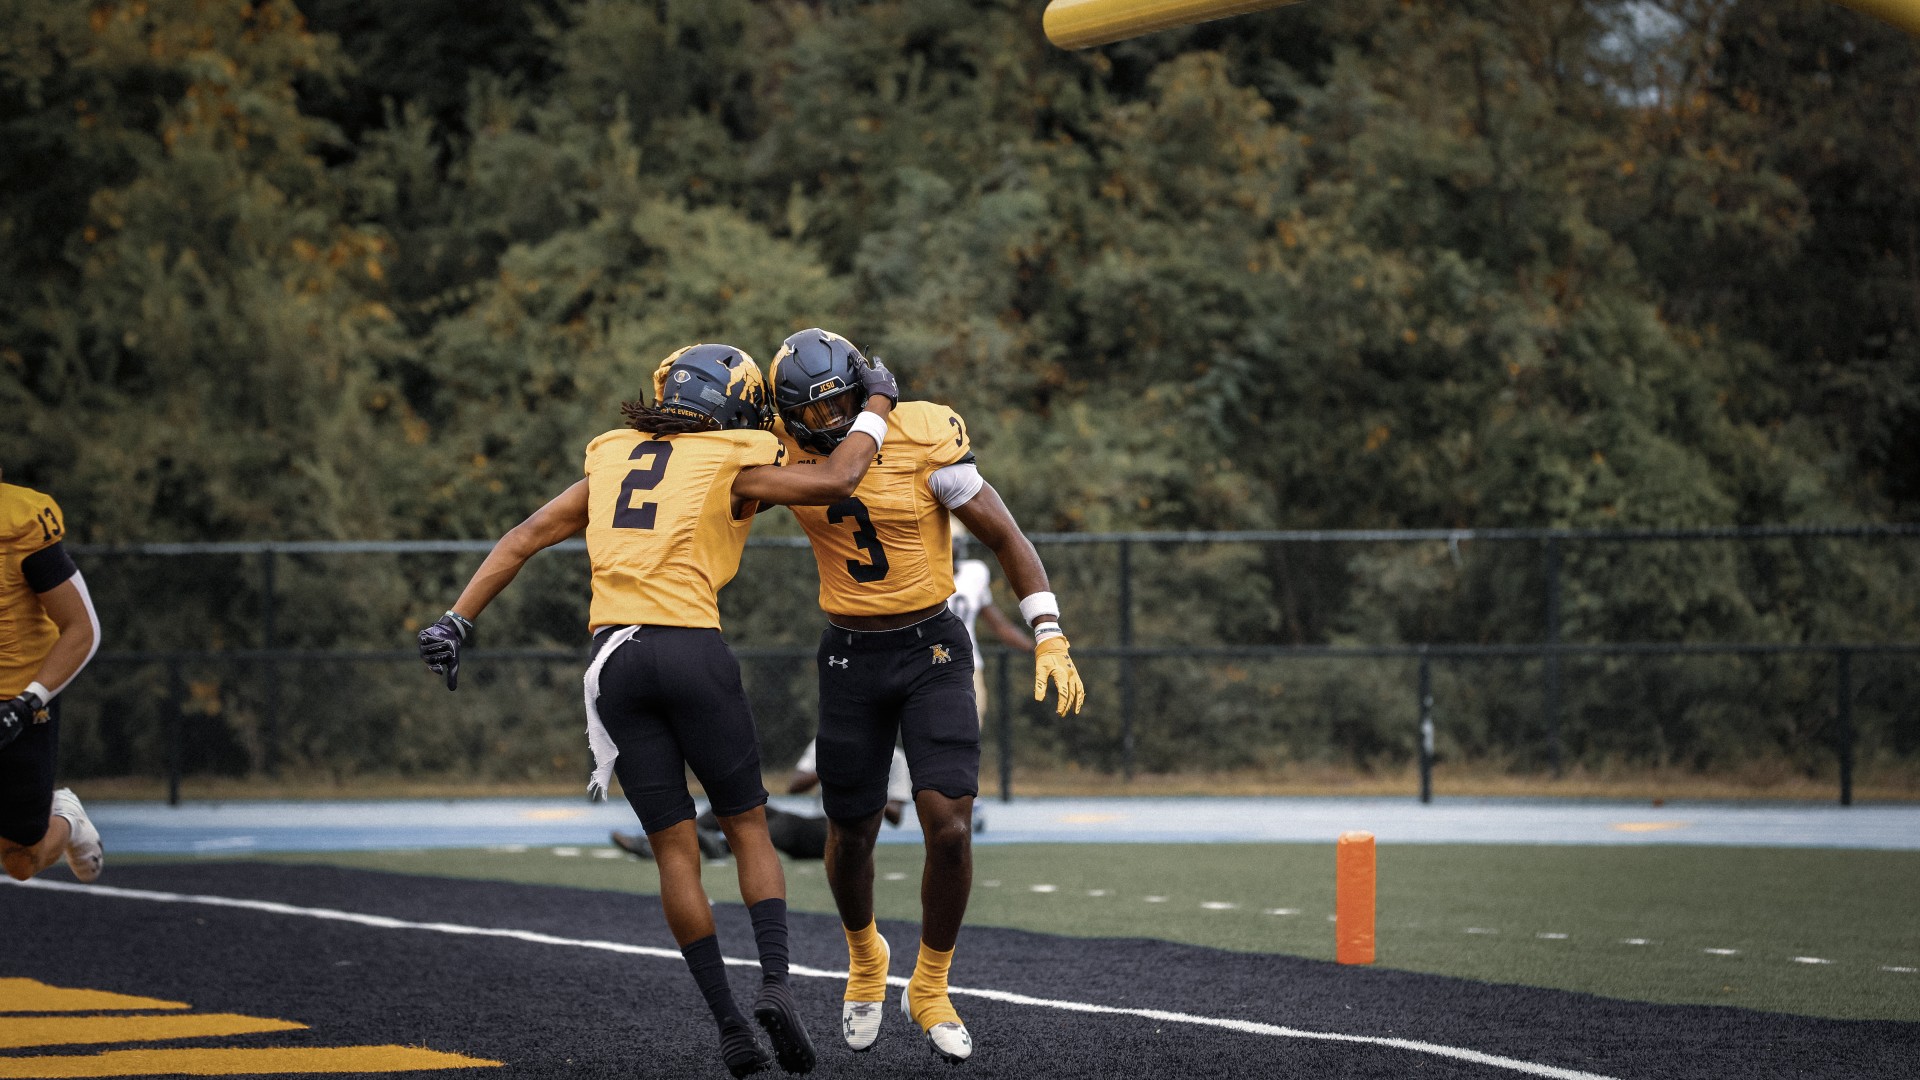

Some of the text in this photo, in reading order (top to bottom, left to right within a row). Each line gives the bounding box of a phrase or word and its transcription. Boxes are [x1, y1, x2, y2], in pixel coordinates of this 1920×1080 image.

[820, 381, 835, 392] JCSU
[677, 409, 697, 418] EVERY
[949, 416, 963, 447] 3
[774, 439, 785, 466] 2
[612, 440, 674, 530] 2
[37, 507, 60, 541] 13
[826, 496, 890, 583] 3
